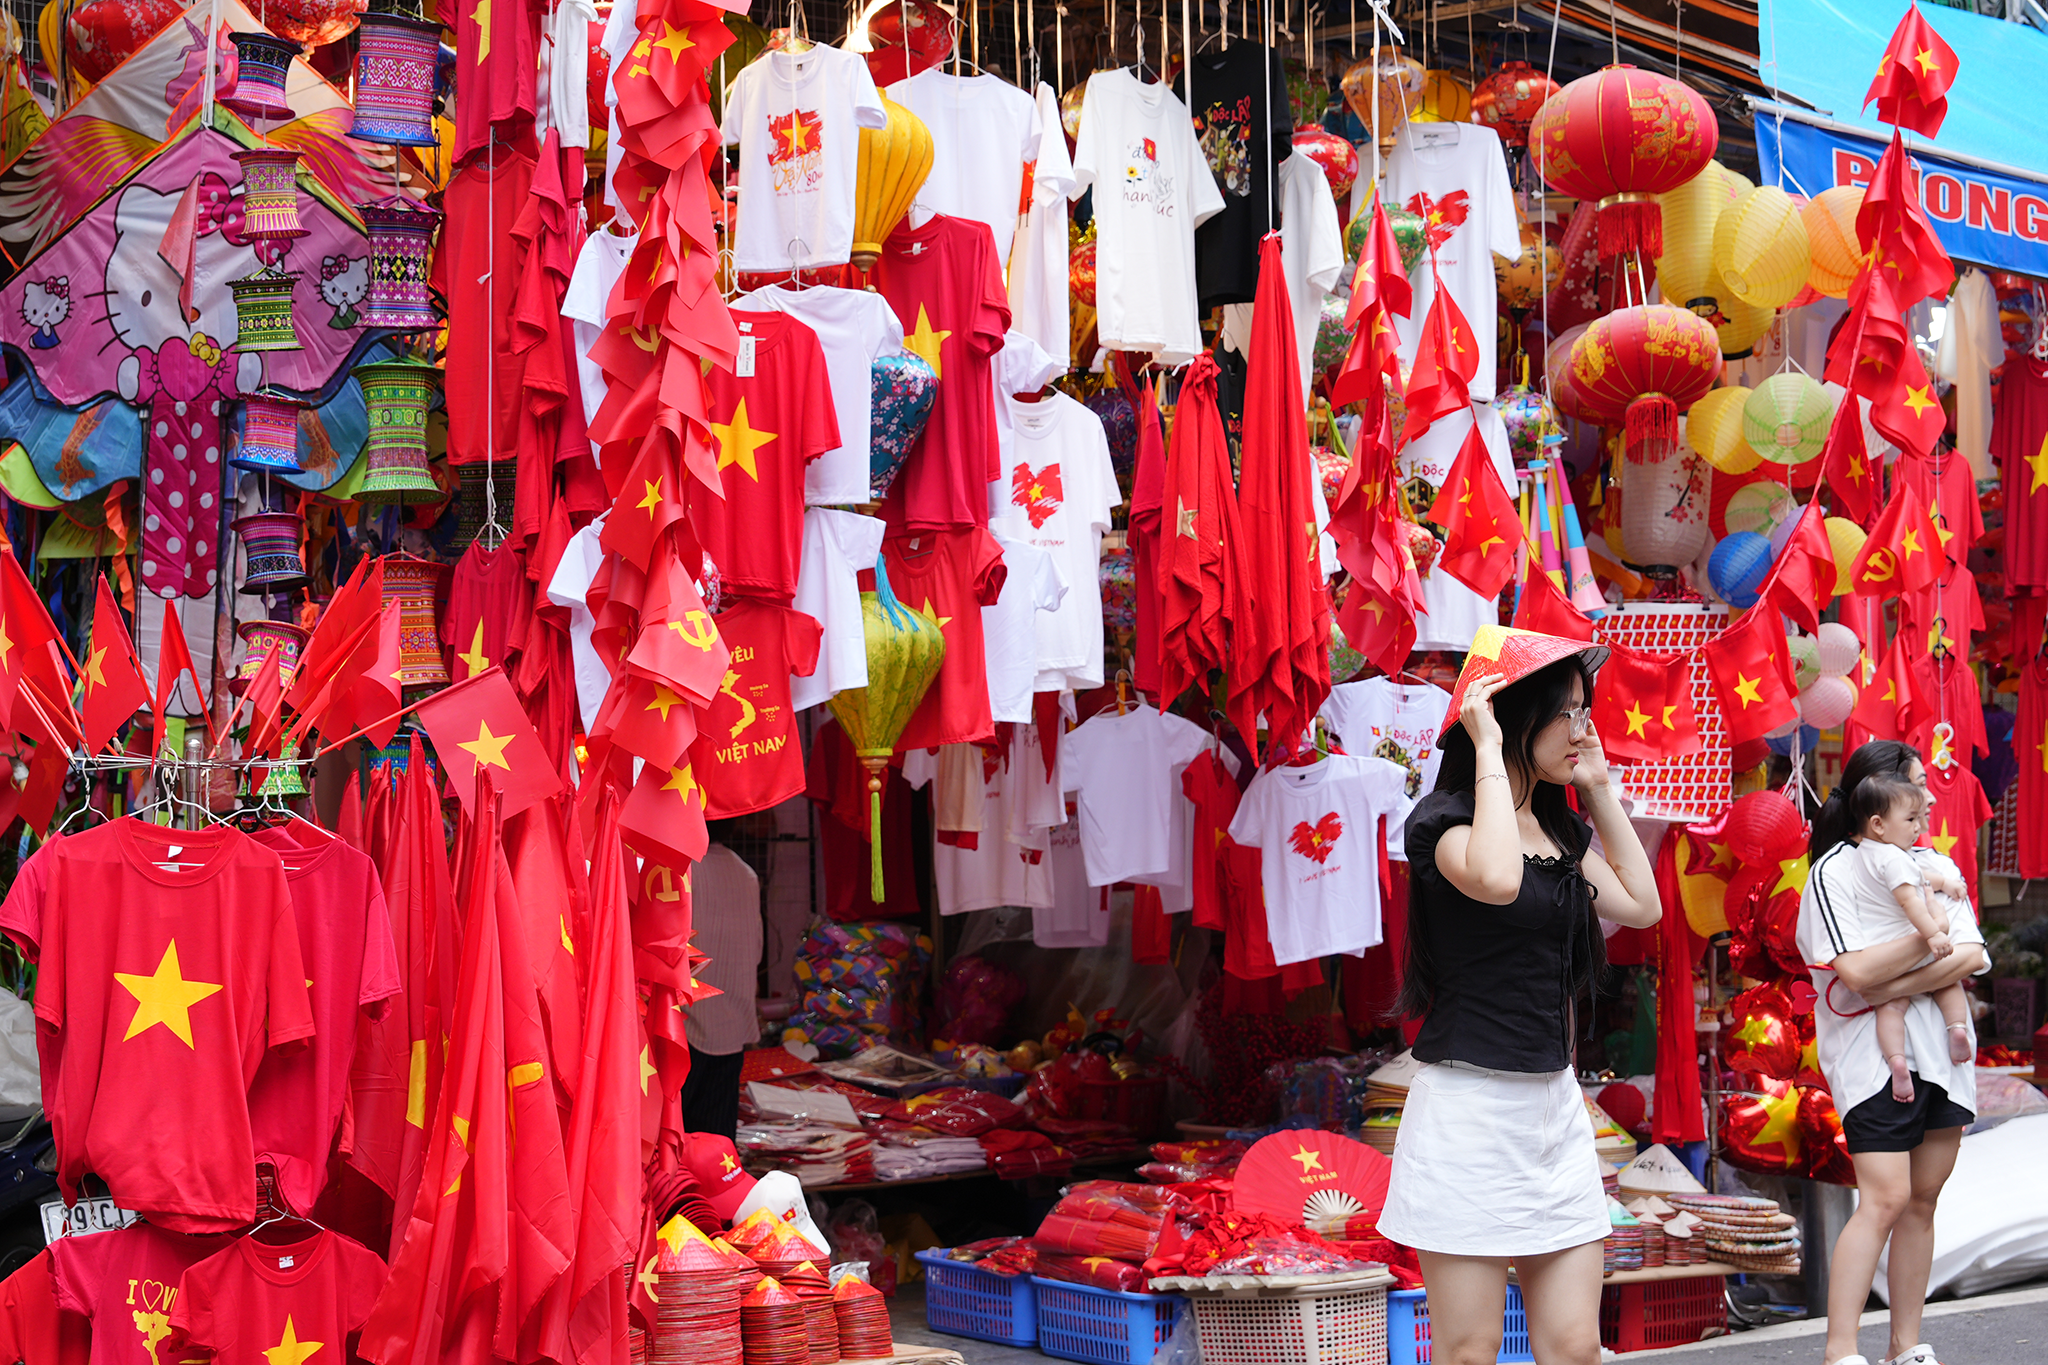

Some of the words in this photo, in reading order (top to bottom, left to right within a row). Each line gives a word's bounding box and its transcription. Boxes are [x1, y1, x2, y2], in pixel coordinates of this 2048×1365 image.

[1832, 147, 2048, 246] PONG
[716, 741, 749, 764] VIỆT
[753, 734, 787, 756] NAM
[1299, 1174, 1318, 1185] VIỆT
[1319, 1171, 1338, 1182] NAM
[126, 1279, 138, 1305] I
